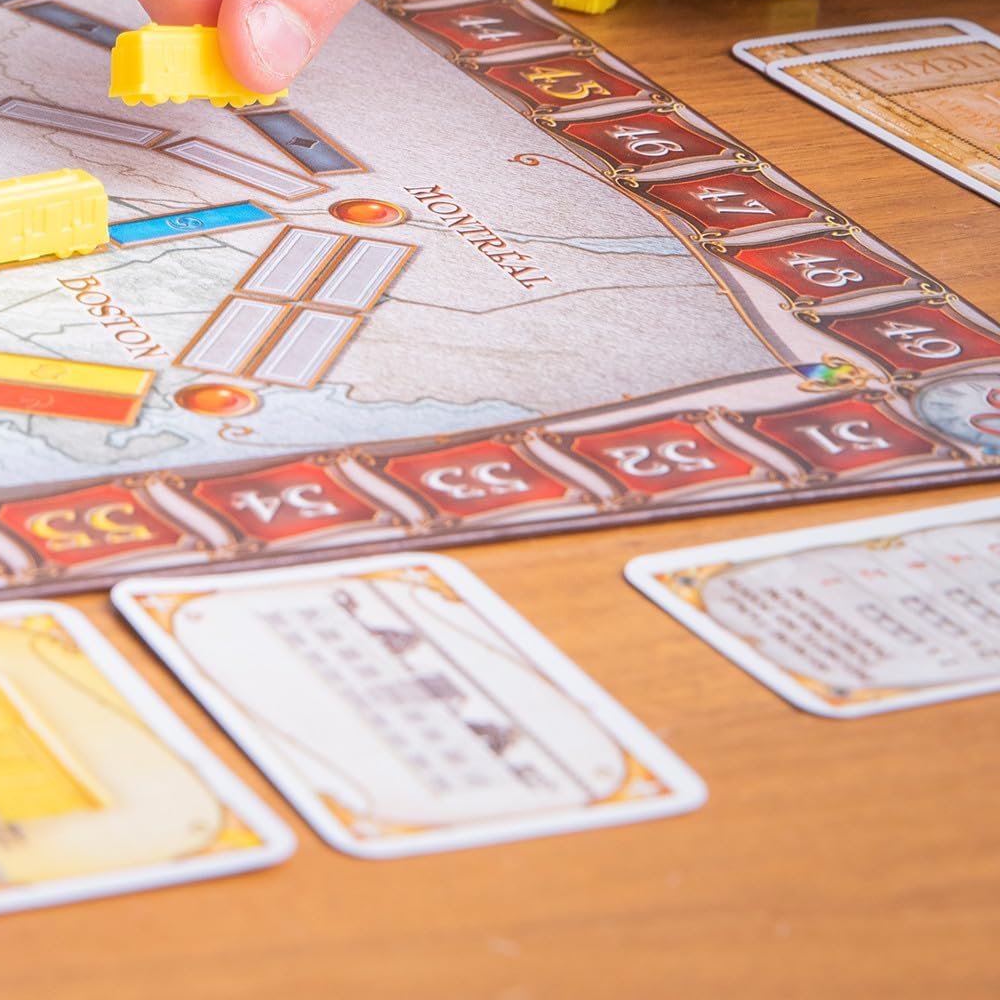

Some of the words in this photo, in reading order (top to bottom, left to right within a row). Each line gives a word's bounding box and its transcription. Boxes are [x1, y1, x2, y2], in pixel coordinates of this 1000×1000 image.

[456, 14, 522, 42] 44
[518, 65, 612, 100] 45
[609, 124, 685, 157] 46
[693, 185, 776, 216] 47
[783, 250, 864, 288] 48
[56, 274, 170, 362] BOSTON
[874, 320, 962, 358] 49
[794, 420, 895, 455] 51
[603, 439, 717, 478] 52
[420, 460, 530, 499] 53
[231, 483, 341, 524] 54
[24, 503, 154, 551] 55
